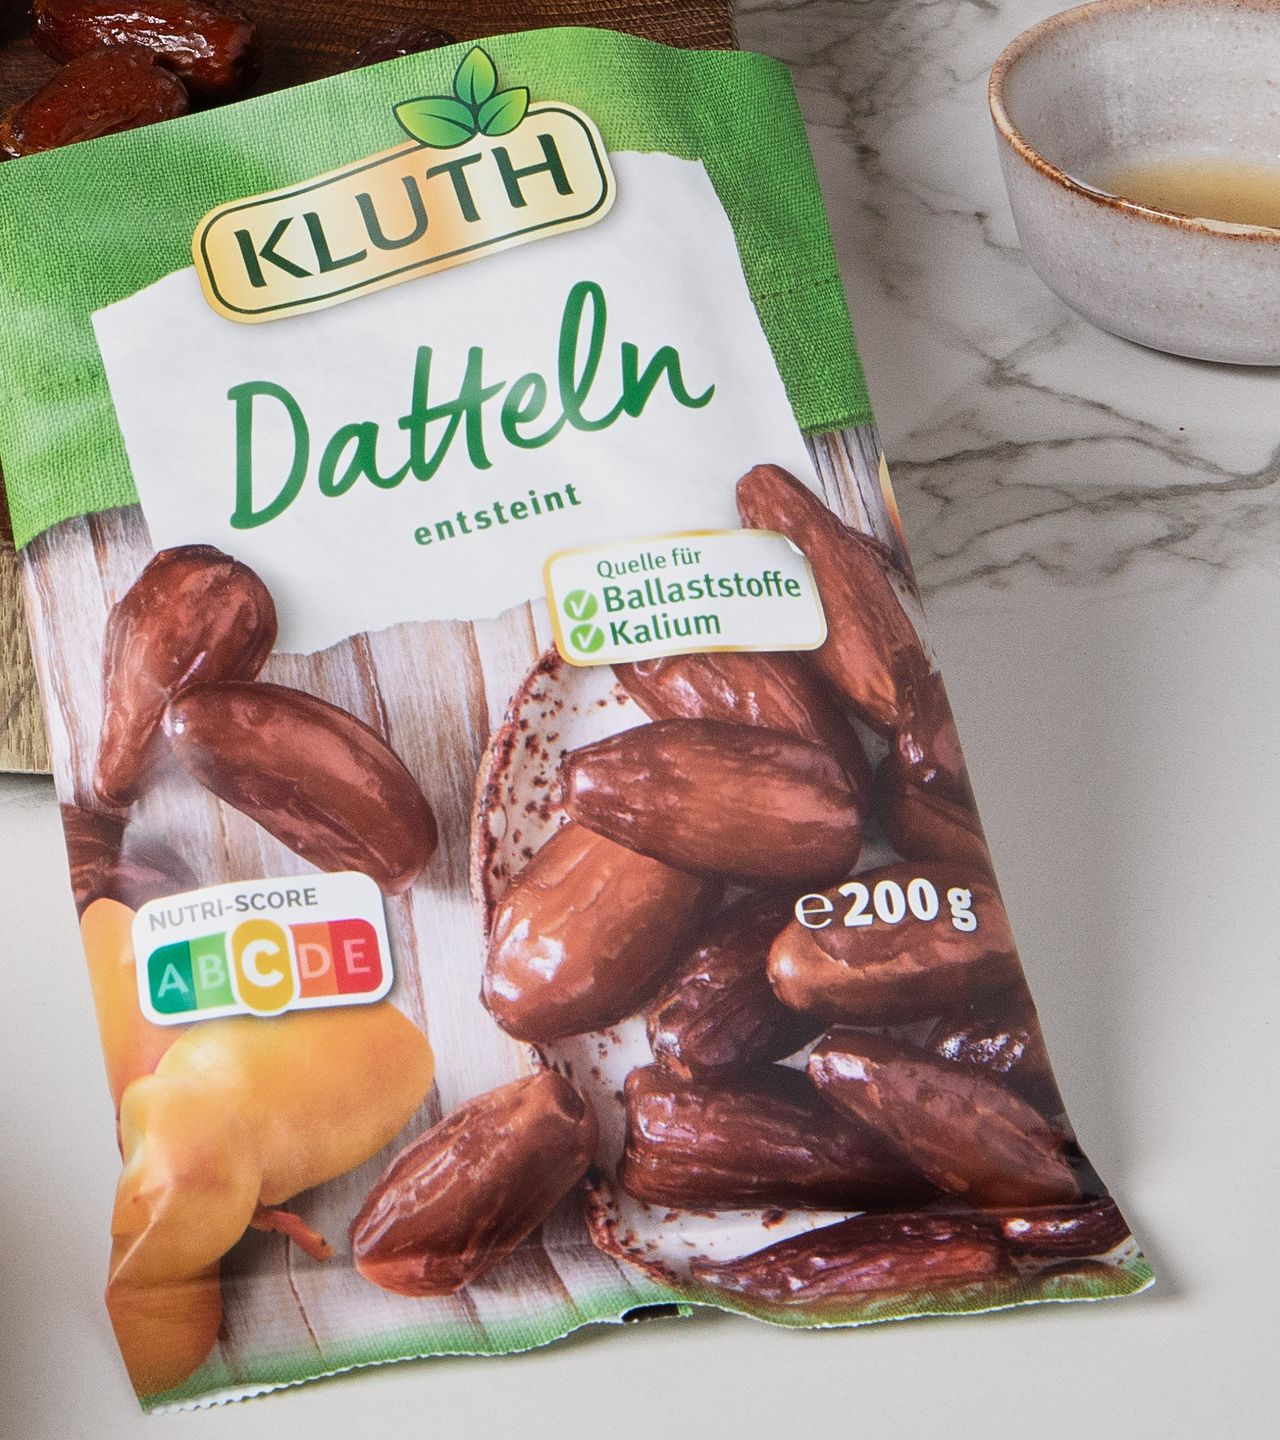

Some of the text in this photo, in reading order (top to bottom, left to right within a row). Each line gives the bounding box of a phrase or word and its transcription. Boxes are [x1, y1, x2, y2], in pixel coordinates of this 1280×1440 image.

[234, 133, 575, 289] KLUTH
[226, 280, 716, 531] Datteln
[413, 483, 583, 546] entsteint
[596, 547, 703, 579] Quelle für
[602, 570, 802, 613] Ballaststoffe
[609, 612, 722, 646] Kalium
[148, 887, 319, 932] NUTRI-SCORE
[837, 877, 940, 928] 200
[946, 886, 978, 933] g
